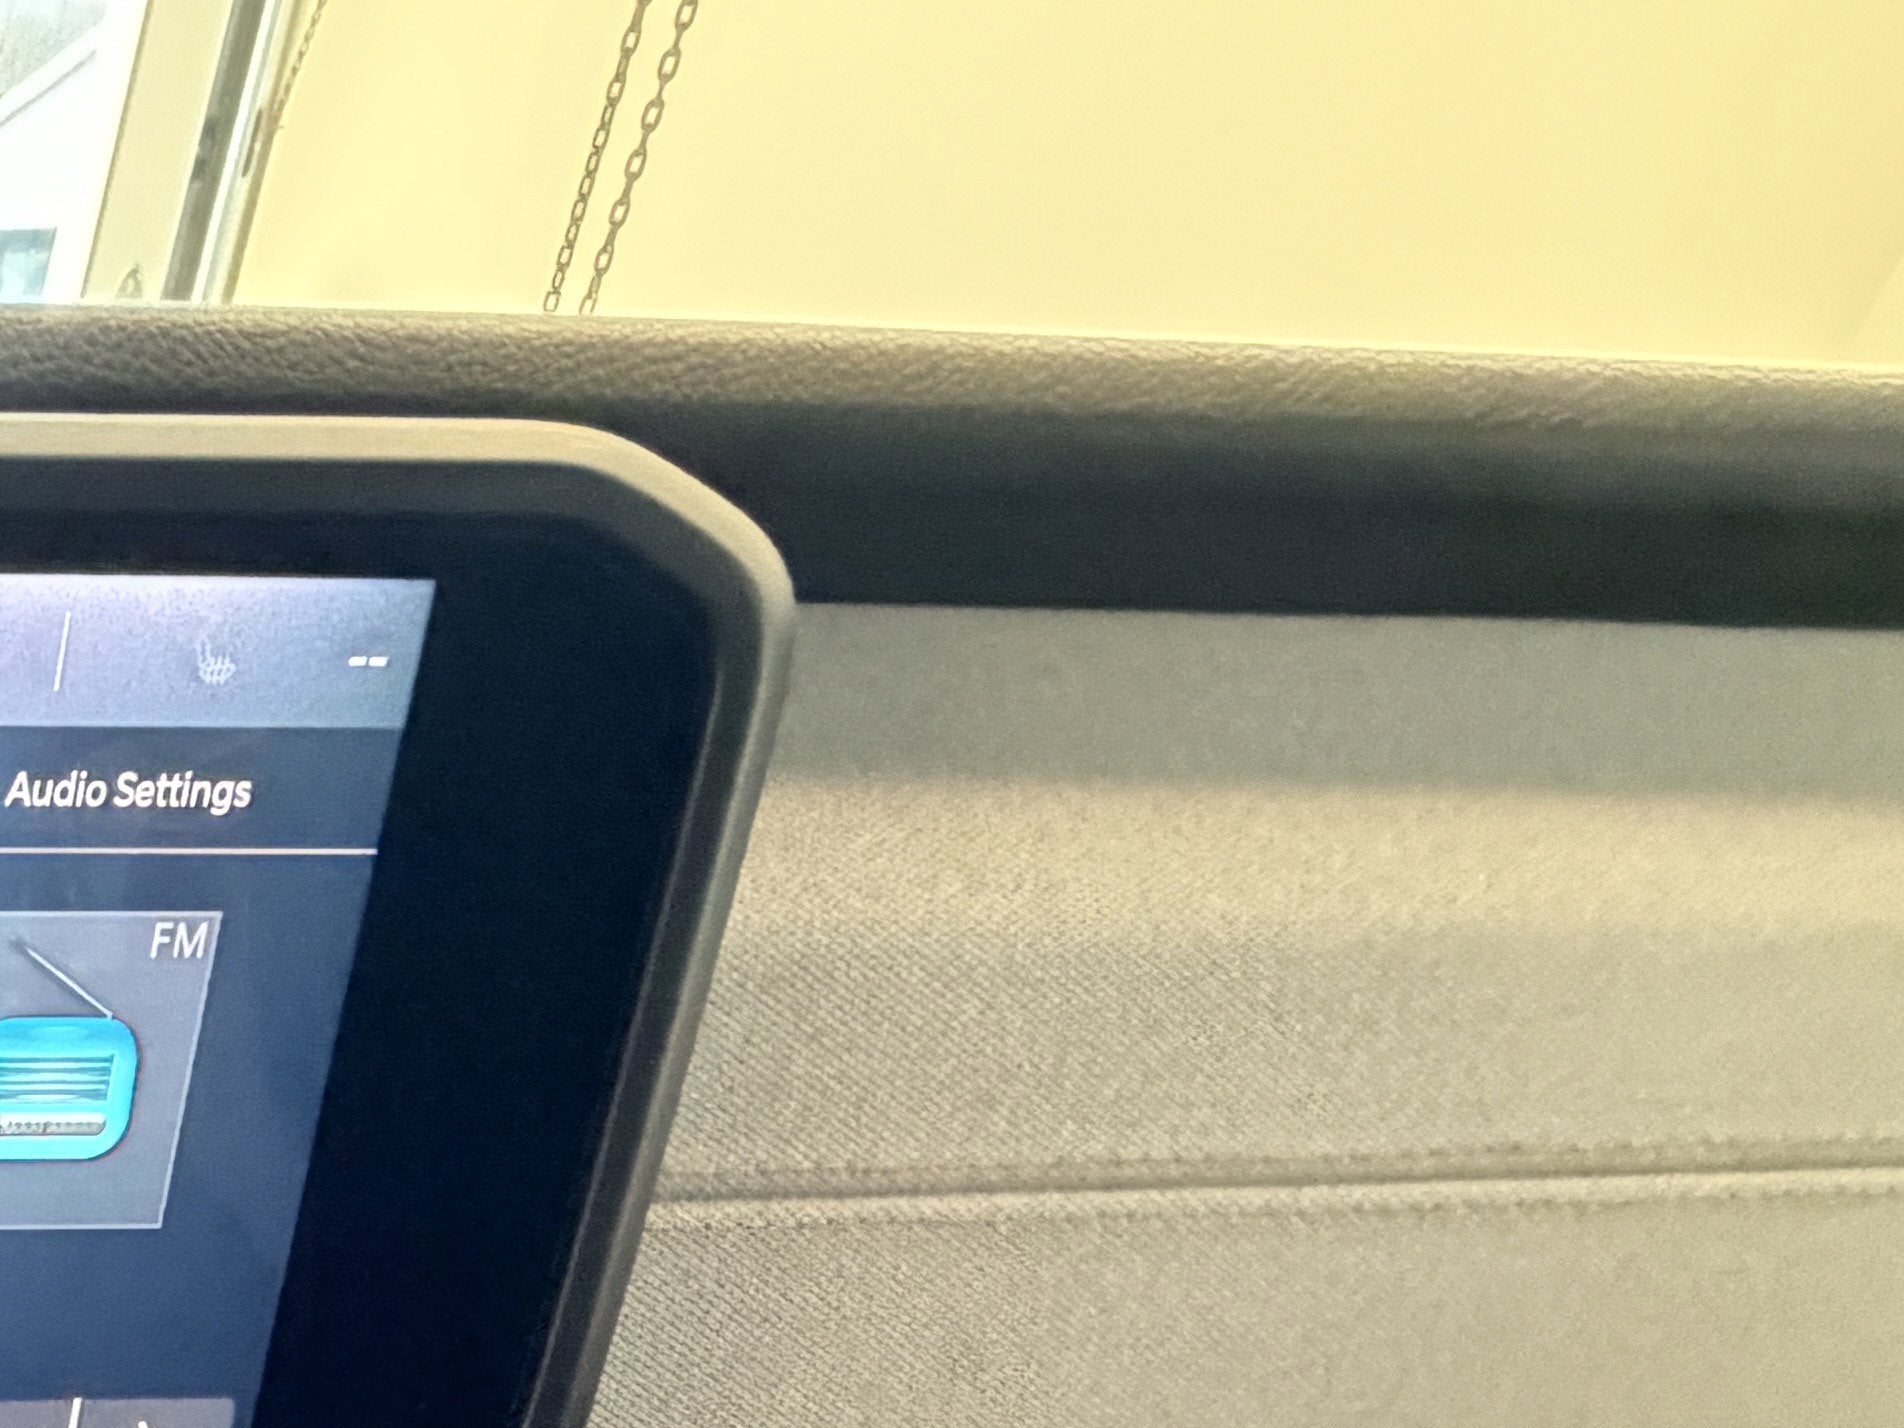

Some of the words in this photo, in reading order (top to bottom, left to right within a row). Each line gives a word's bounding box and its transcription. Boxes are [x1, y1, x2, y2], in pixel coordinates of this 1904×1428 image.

[3, 769, 107, 808] Audio
[113, 771, 253, 815] Settings
[150, 921, 208, 959] FM
